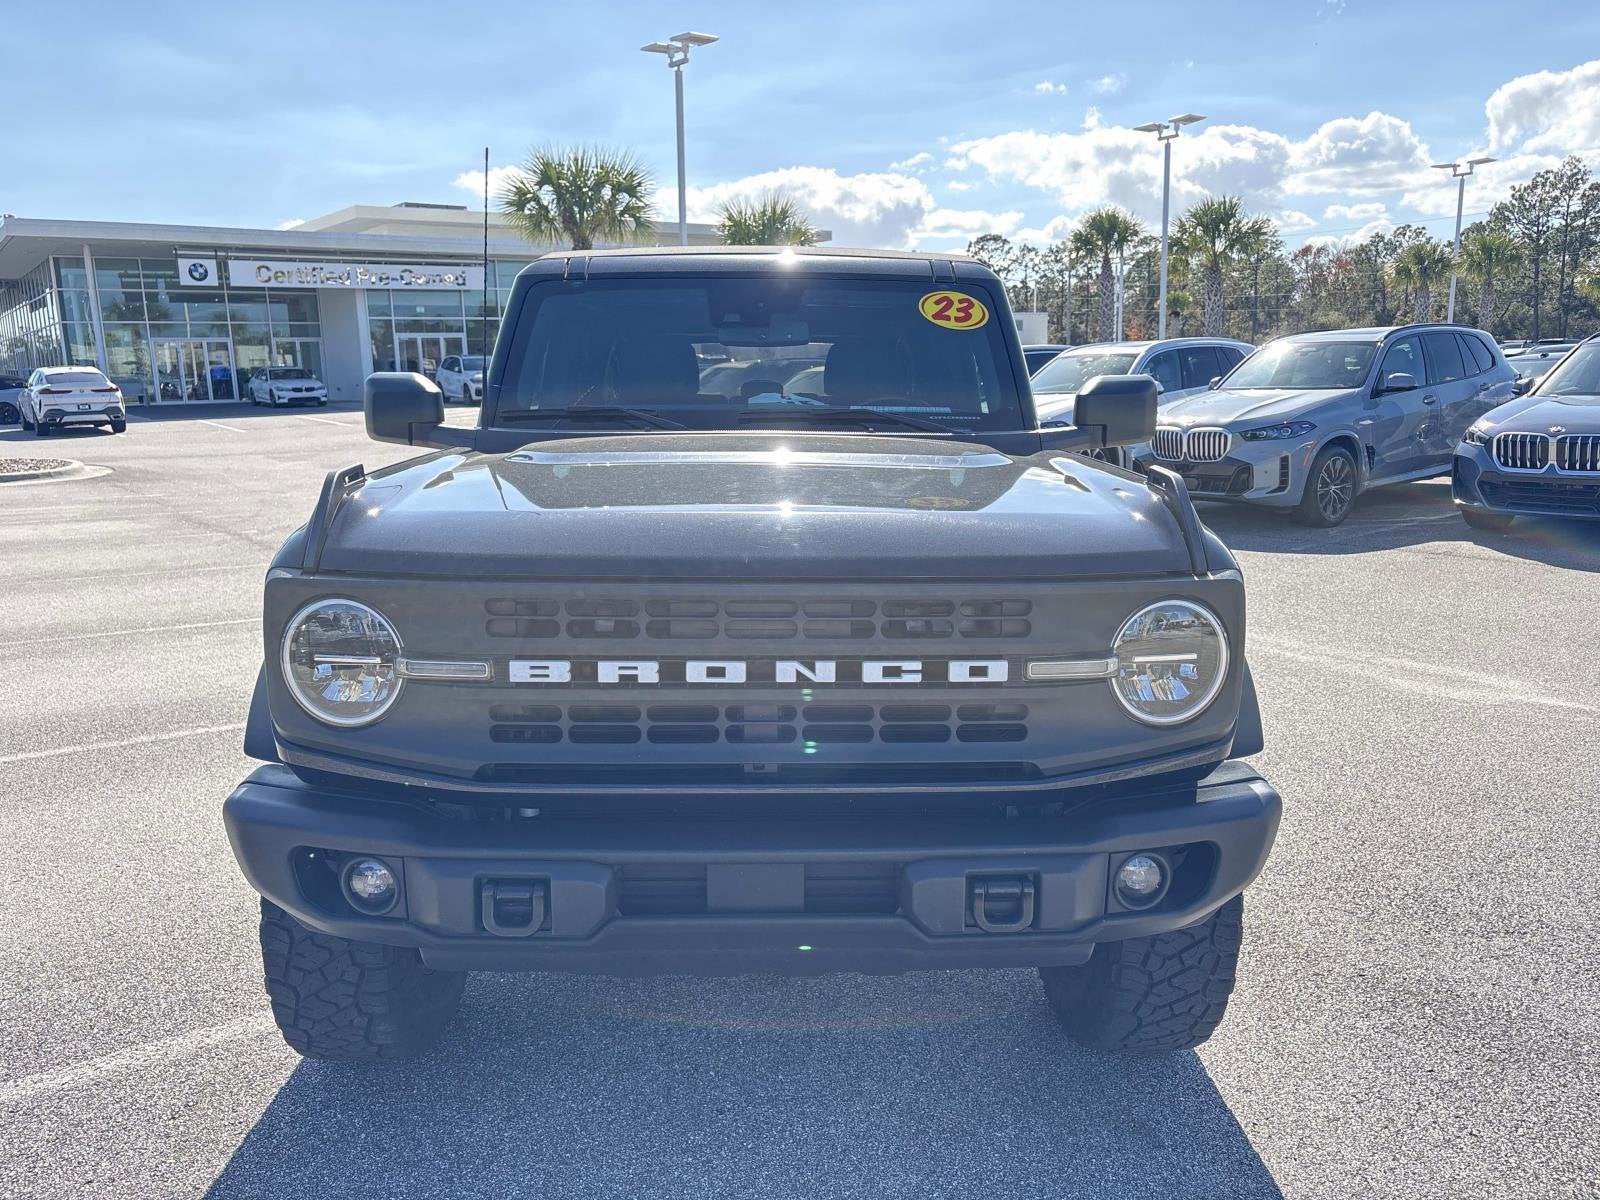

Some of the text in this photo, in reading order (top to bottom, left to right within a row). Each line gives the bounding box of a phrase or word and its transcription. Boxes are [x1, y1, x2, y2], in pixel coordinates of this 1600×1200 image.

[256, 265, 351, 285] Certified
[932, 296, 975, 323] 23
[508, 660, 1009, 682] BRONCO
